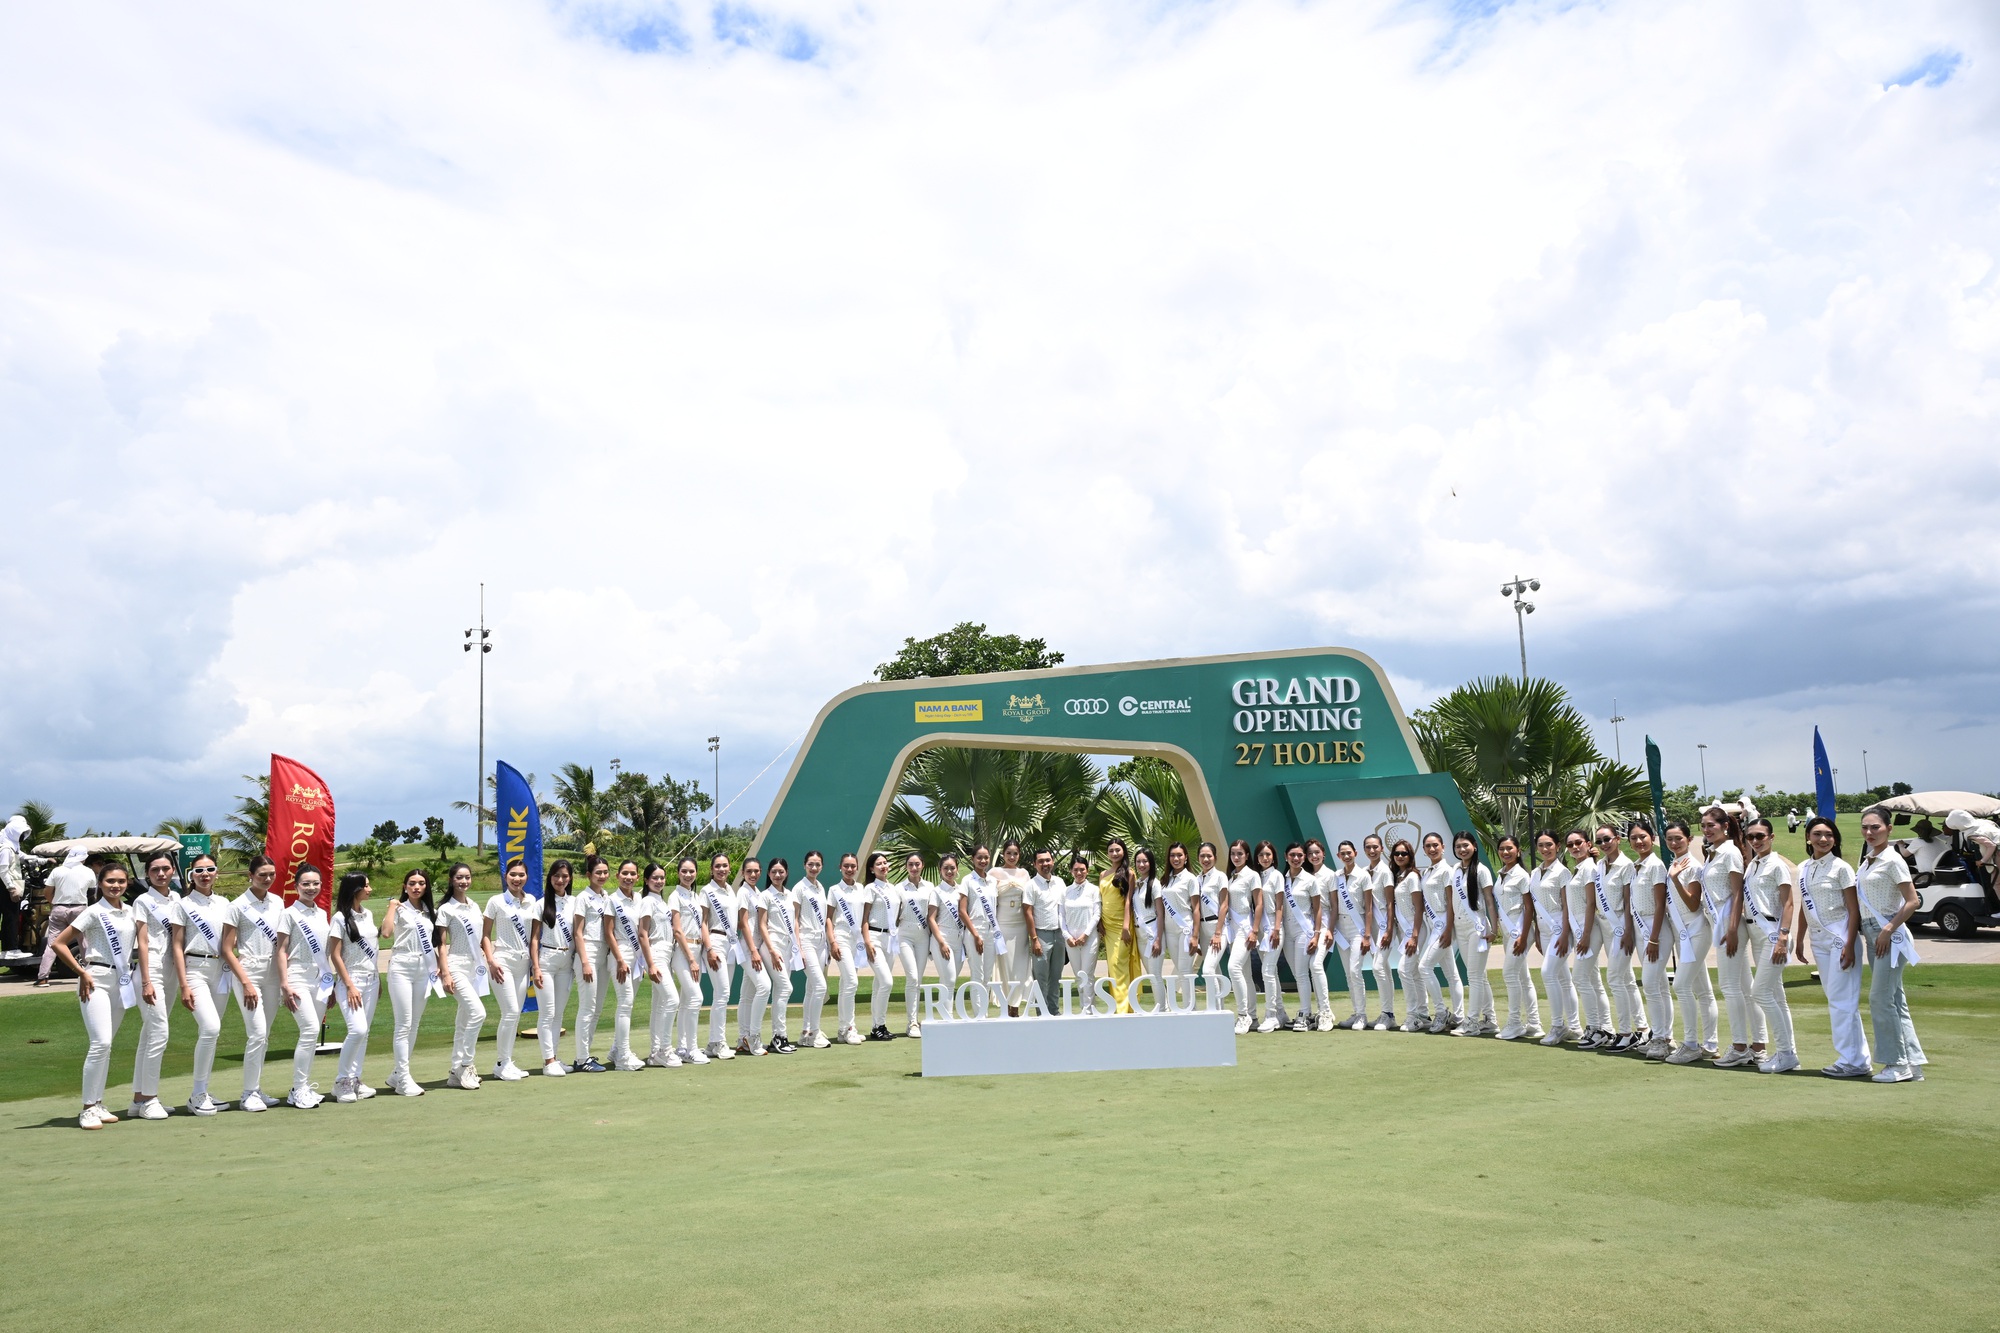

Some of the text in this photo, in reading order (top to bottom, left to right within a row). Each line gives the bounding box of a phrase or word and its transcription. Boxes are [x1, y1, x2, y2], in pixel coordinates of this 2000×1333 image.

[1232, 676, 1361, 707] GRAND
[951, 704, 979, 712] BANK
[1002, 708, 1051, 717] ROYAL GROUP
[1140, 699, 1191, 710] CENTRAL
[1233, 707, 1363, 734] OPENING
[1235, 741, 1366, 766] 27 HOLES
[1127, 973, 1232, 1018] CUP
